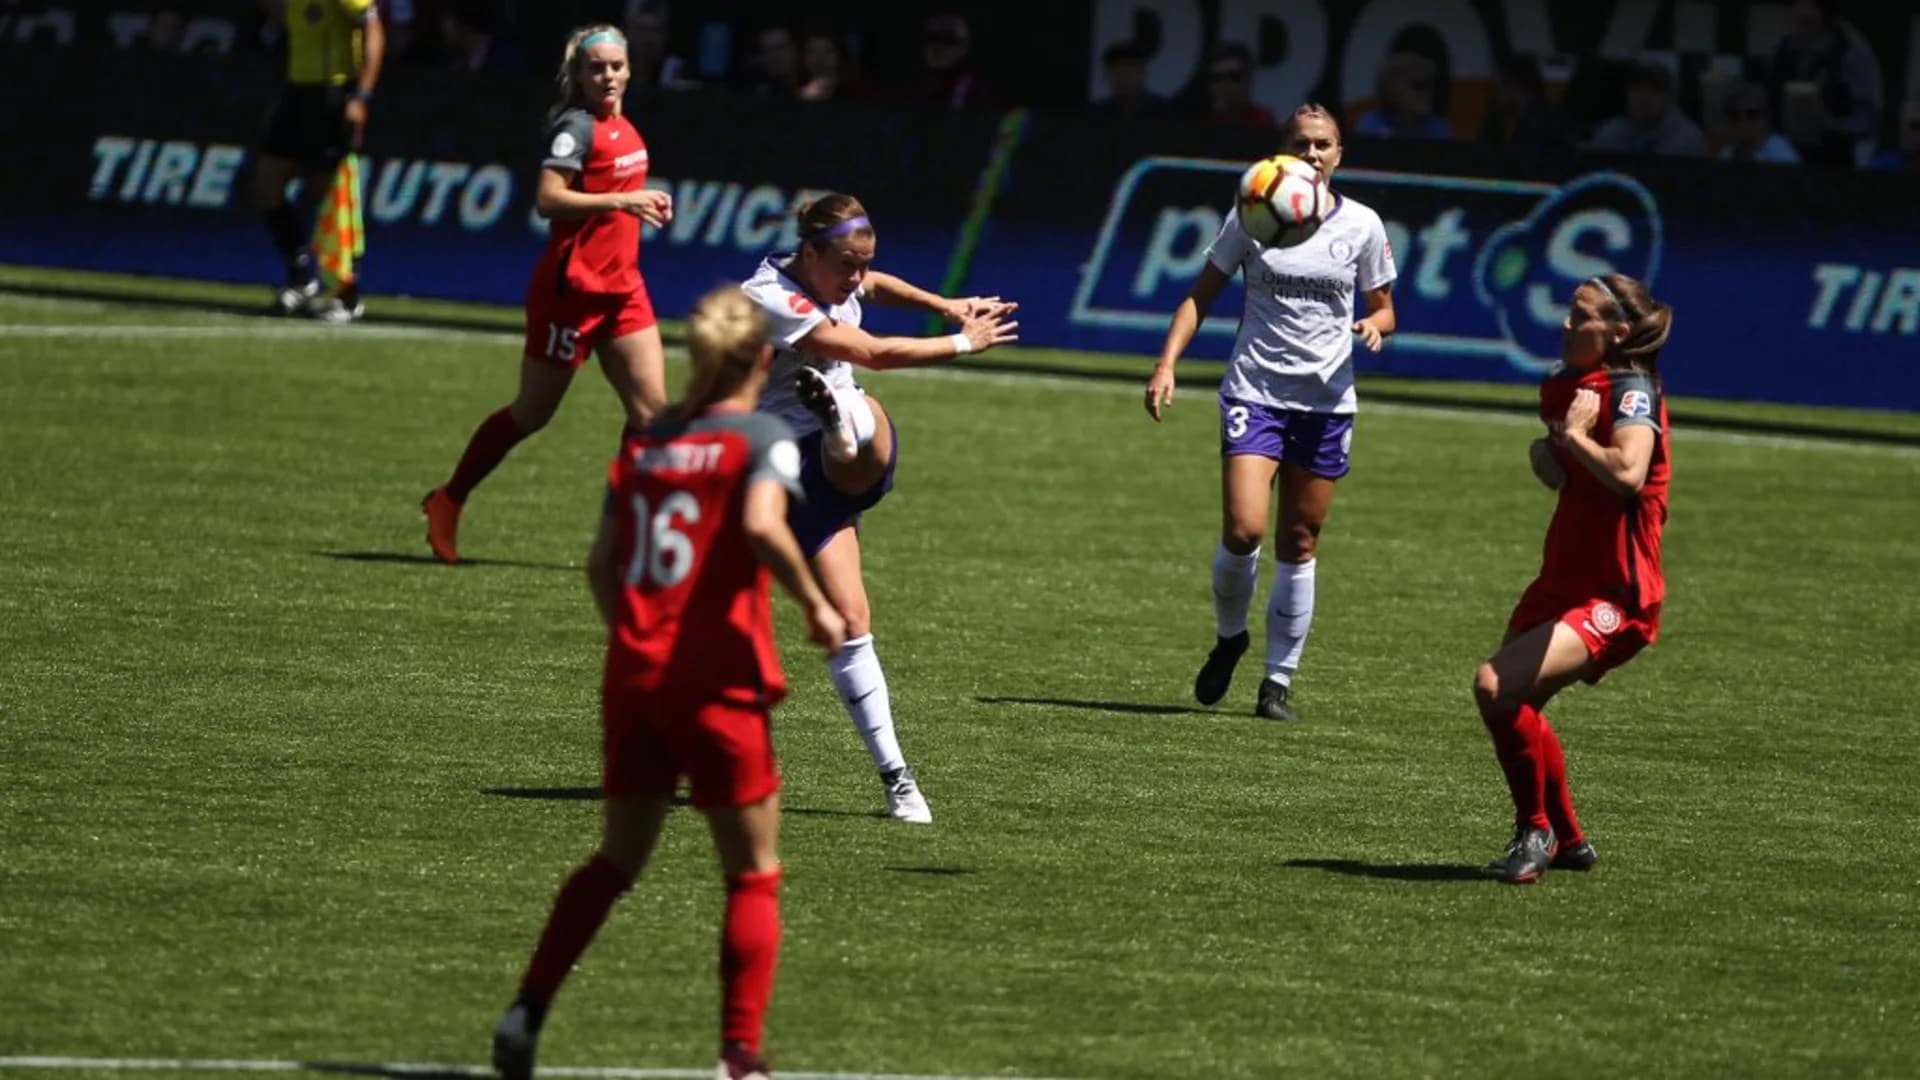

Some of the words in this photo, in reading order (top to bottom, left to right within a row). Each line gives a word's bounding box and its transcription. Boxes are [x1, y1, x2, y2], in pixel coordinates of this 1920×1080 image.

[88, 135, 246, 208] TIRE
[356, 155, 512, 231] UTO
[545, 321, 582, 361] 15
[1227, 406, 1250, 438] 3
[623, 491, 700, 588] 16
